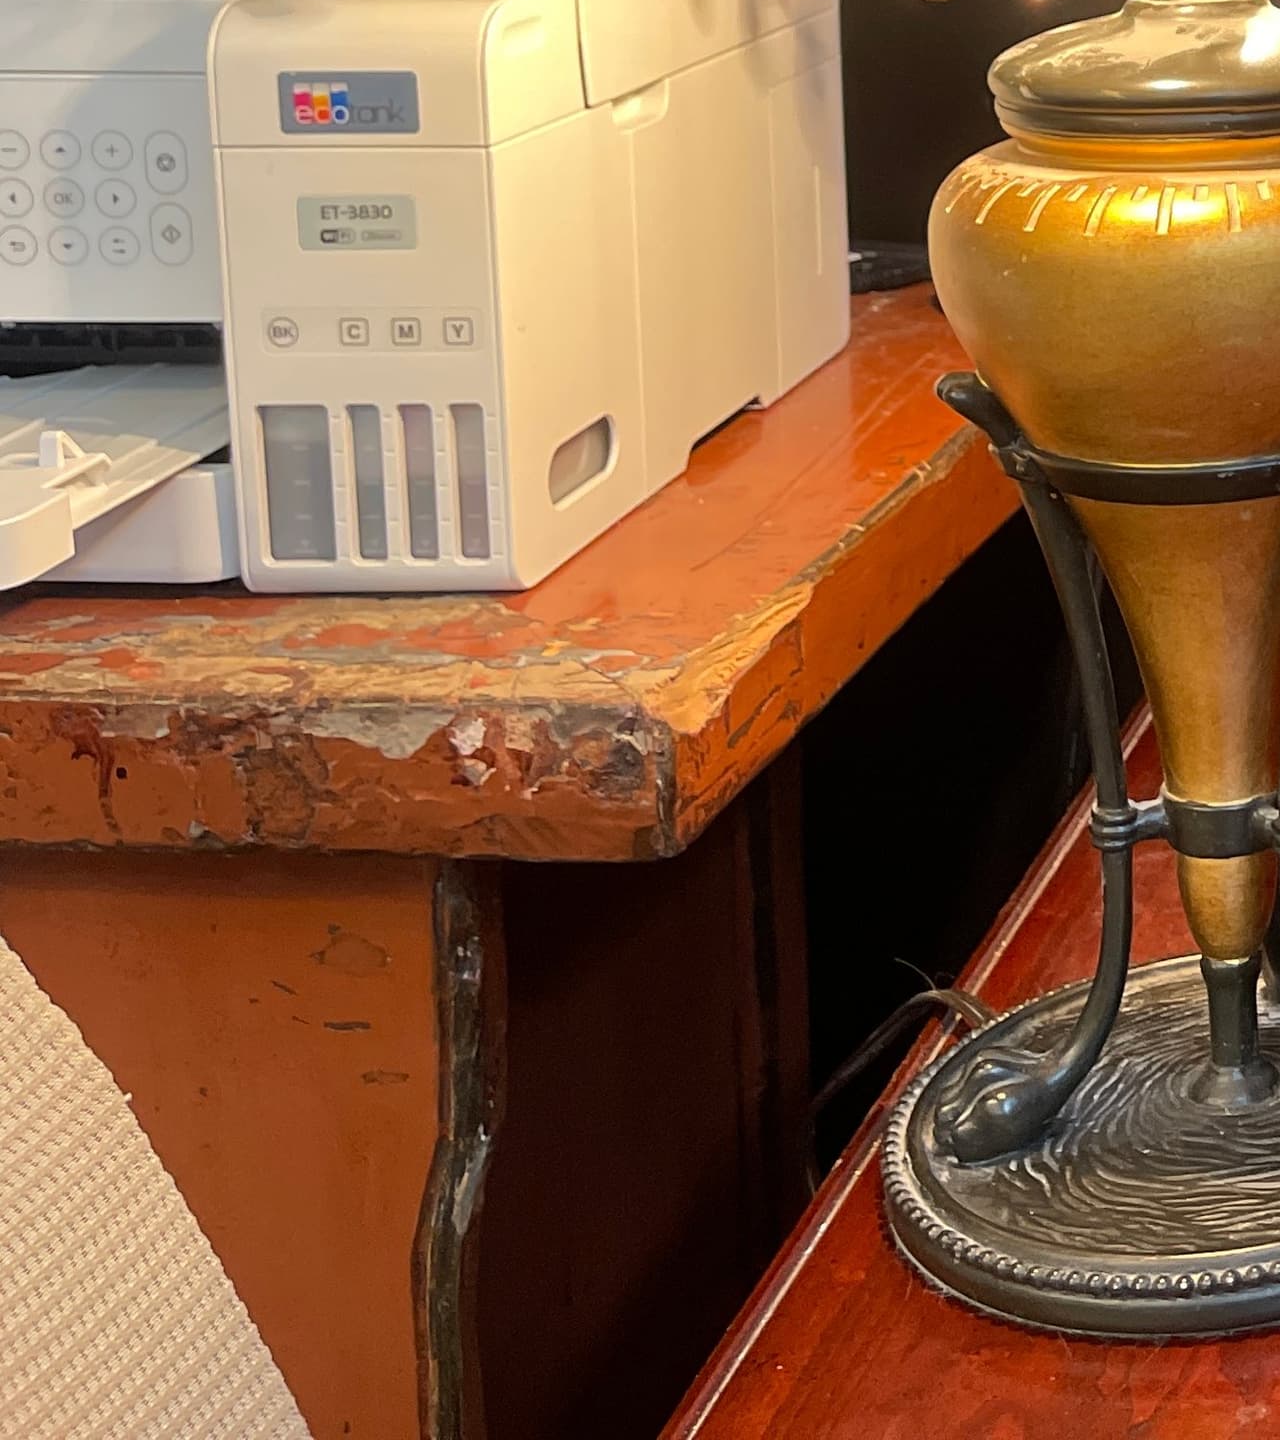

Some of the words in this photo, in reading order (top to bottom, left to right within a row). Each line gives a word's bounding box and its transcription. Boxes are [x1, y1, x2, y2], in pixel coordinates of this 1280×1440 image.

[54, 192, 73, 205] OK
[321, 204, 394, 220] ET-3830
[272, 325, 295, 338] BK
[347, 324, 361, 340] C
[398, 324, 415, 339] M
[451, 324, 465, 339] Y
